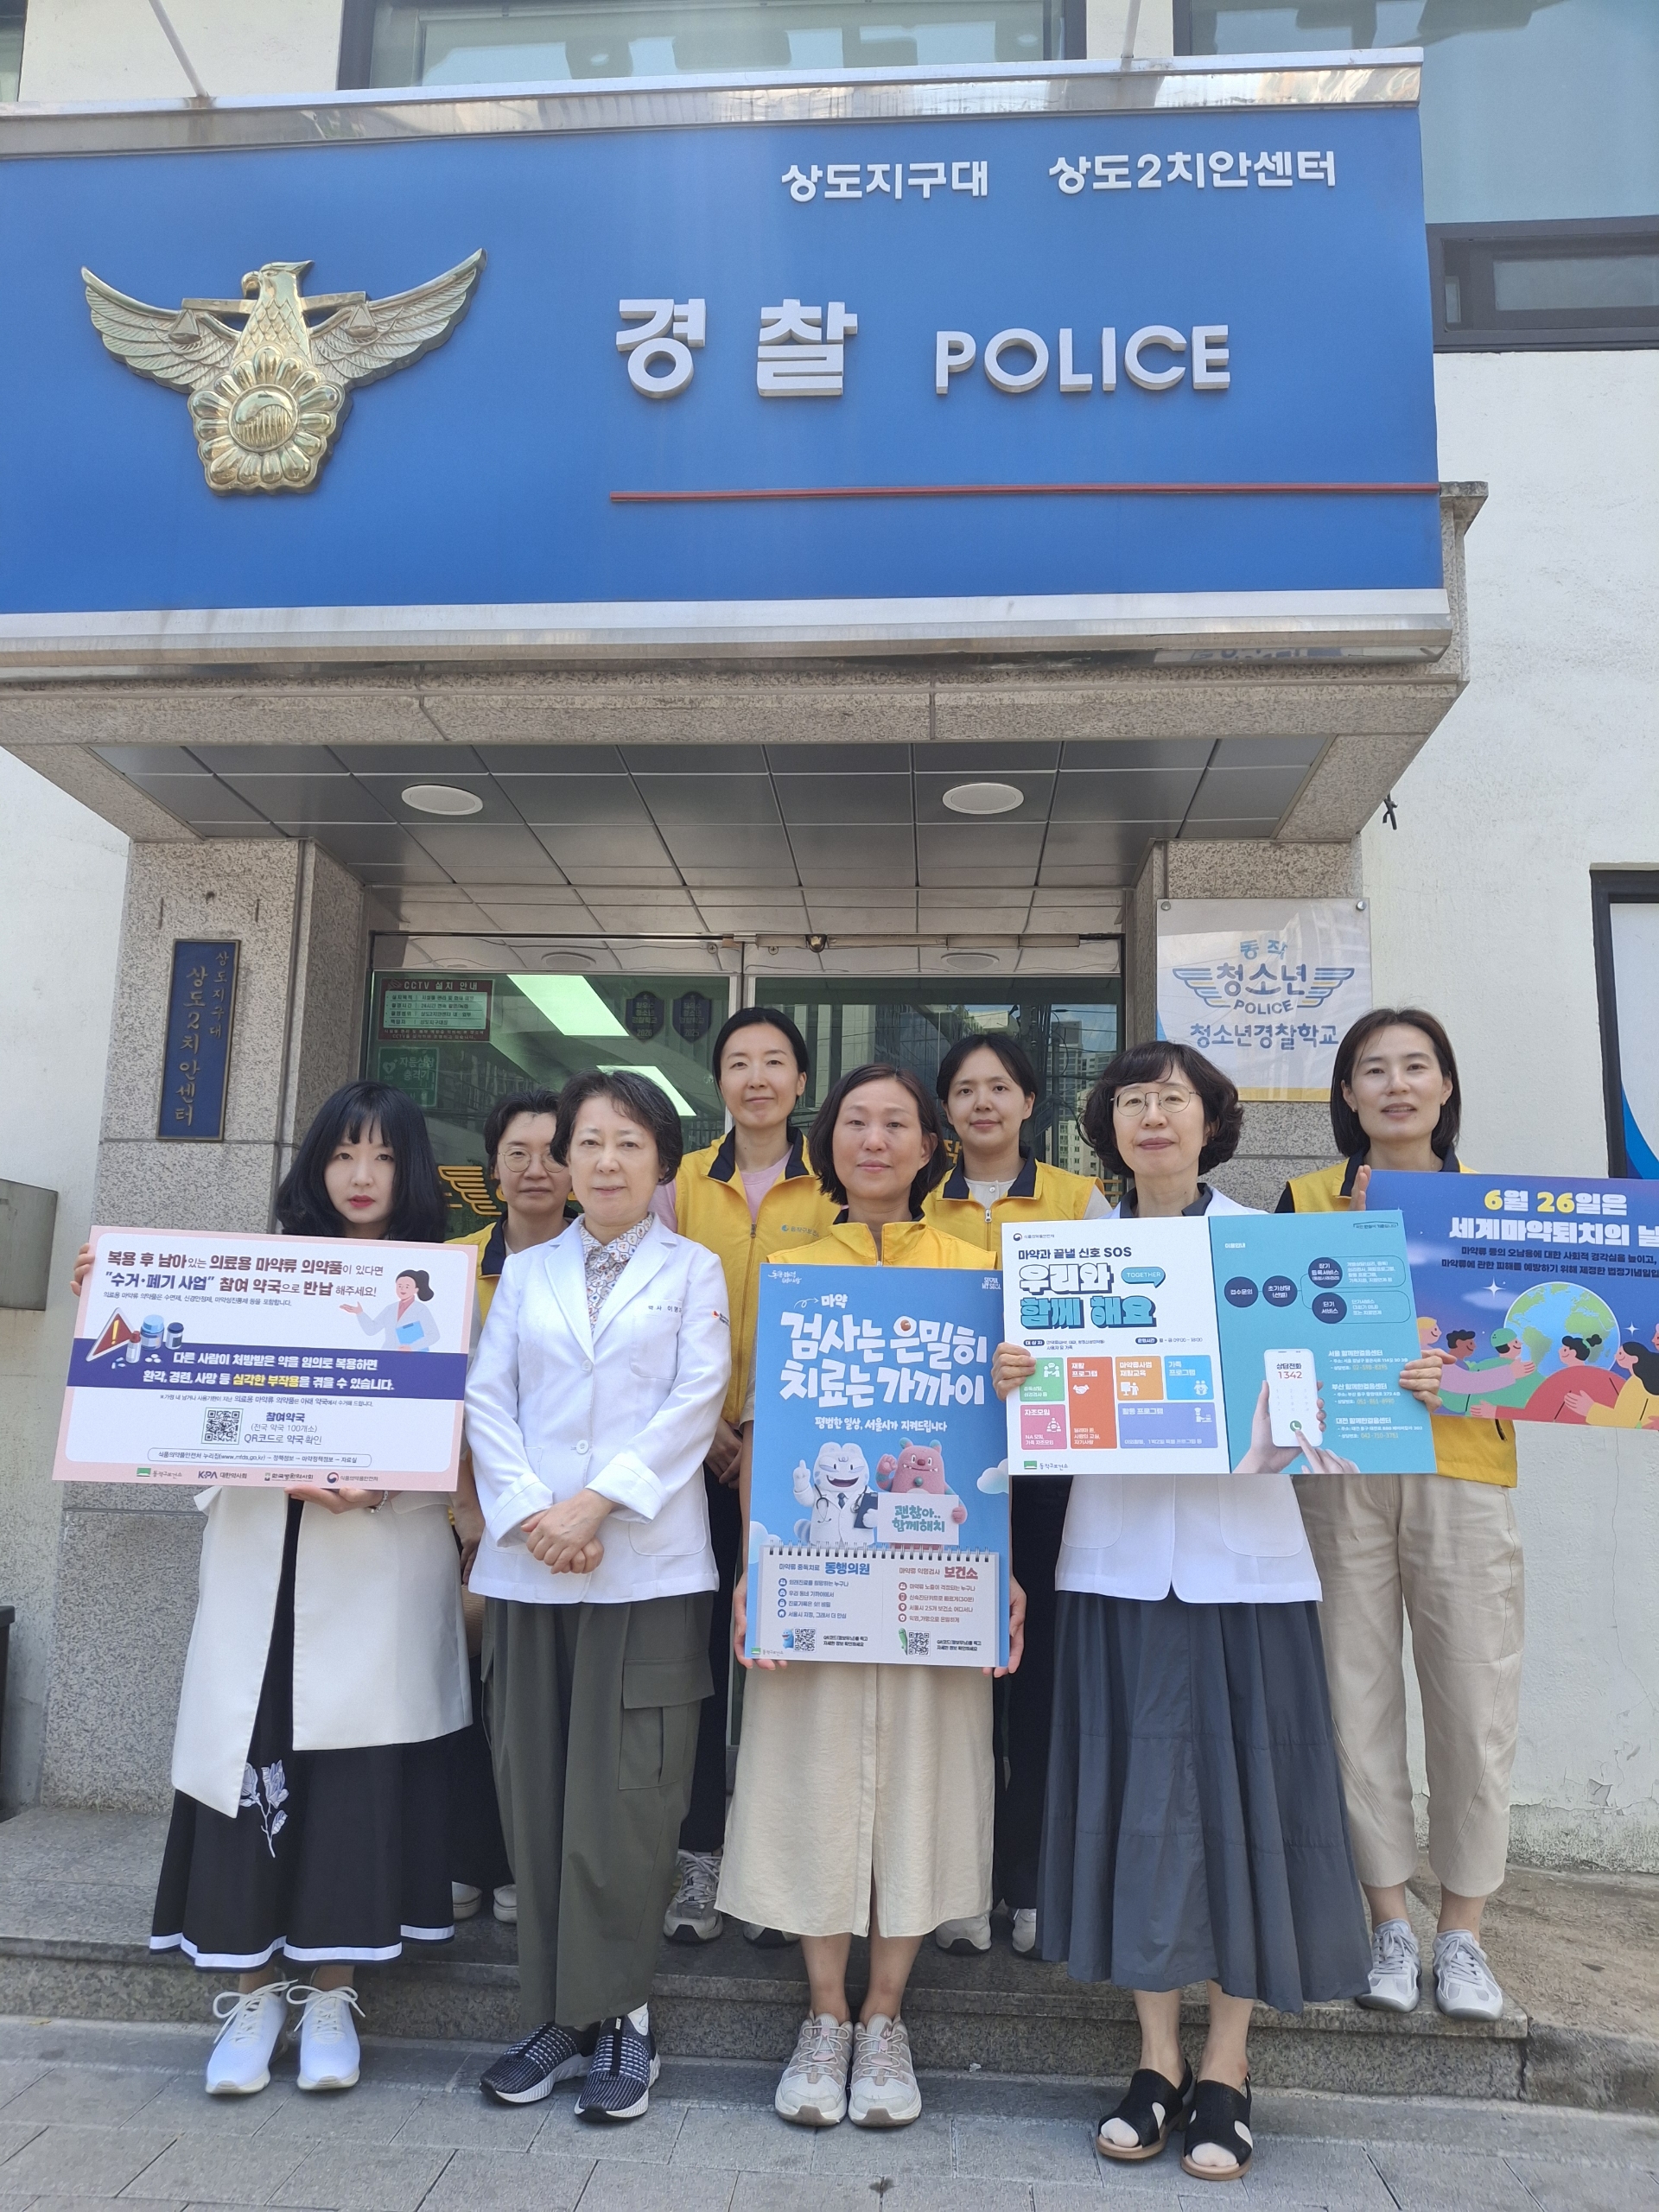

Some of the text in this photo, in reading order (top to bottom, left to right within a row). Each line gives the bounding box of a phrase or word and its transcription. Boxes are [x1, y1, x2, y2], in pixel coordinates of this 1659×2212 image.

[781, 150, 1337, 203] 상도지구대 상도2치안센터
[935, 324, 1231, 395] POLICE
[435, 982, 453, 990] 설치
[460, 982, 477, 990] 안내
[1217, 963, 1306, 996] 청소년
[208, 950, 229, 1039] 상도지구대
[1233, 999, 1294, 1014] POLICE
[175, 965, 208, 1126] 상도2치안센터
[1190, 1023, 1339, 1050] 청소년경찰학교
[1484, 1189, 1627, 1216] 6월 26일은
[1449, 1217, 1630, 1246] 세계마약퇴치의
[1019, 1247, 1132, 1260] 마약과 끝낼 신호 SOS
[1461, 1246, 1486, 1255] 마약류
[1489, 1248, 1505, 1256] 등의
[1508, 1249, 1542, 1258] 오남용에
[1544, 1250, 1561, 1259] 대한
[1563, 1251, 1589, 1261] 사회적
[1591, 1252, 1625, 1262] 경각심을
[108, 1251, 136, 1266] 복용
[140, 1252, 154, 1267] 후
[209, 1255, 251, 1271] 의료용
[256, 1257, 297, 1274] 마약류
[301, 1259, 353, 1275] 의약품이
[355, 1265, 384, 1276] 있다면
[1441, 1259, 1605, 1275] 마약류에 관한 피해를 예방하기 위해 제정한
[219, 1276, 249, 1293] 참여
[252, 1278, 301, 1294] 약국으로
[303, 1281, 334, 1297] 반납
[335, 1285, 377, 1297] 해주세요!
[1019, 1262, 1114, 1294] 우리와
[821, 1294, 848, 1308] 마약
[1020, 1295, 1157, 1329] 함께 해요
[780, 1312, 988, 1370] 검사는 은밀히
[173, 1352, 378, 1371] 다른 사람이 처방받은 약을 임의로 복용하면
[143, 1370, 395, 1390] 환각, 경련, 사망 등 심각한 부작용을 겪을 수 있습니다.
[779, 1358, 984, 1408] 치료는 가까이
[266, 1412, 306, 1422] 참여약국
[815, 1416, 947, 1433] 평범한 일상, 서울시가 지켜드립니다
[251, 1423, 268, 1432] (전국
[288, 1424, 318, 1433] 100개소)
[244, 1433, 322, 1446] QR코드로 약국 확인
[198, 1471, 218, 1479] KPA
[892, 1517, 944, 1532] 함께해치
[825, 1562, 870, 1575] 동행의원
[944, 1567, 978, 1580] 보건소
